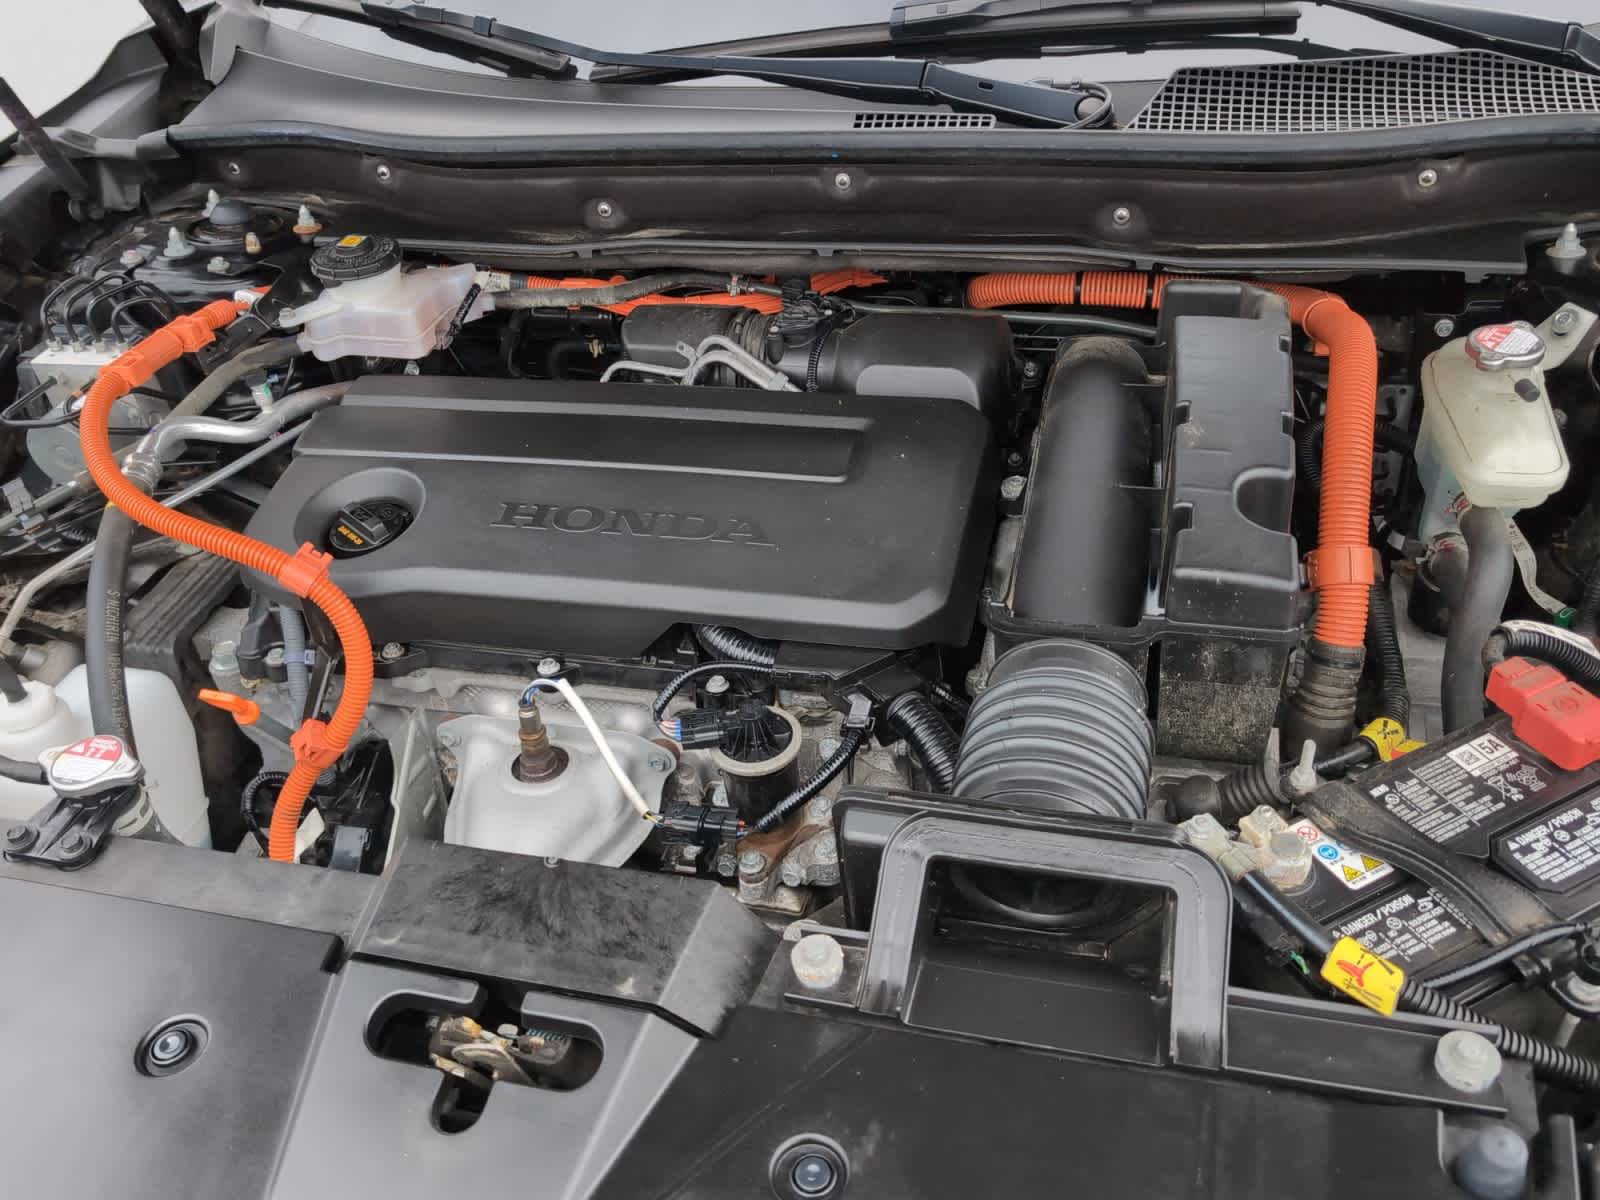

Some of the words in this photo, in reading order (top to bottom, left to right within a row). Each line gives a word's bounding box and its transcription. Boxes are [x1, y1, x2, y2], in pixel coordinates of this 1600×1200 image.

[489, 502, 776, 548] HONDA
[1478, 739, 1505, 754] 5A
[1341, 912, 1377, 936] DANGER
[1380, 894, 1415, 916] POISON
